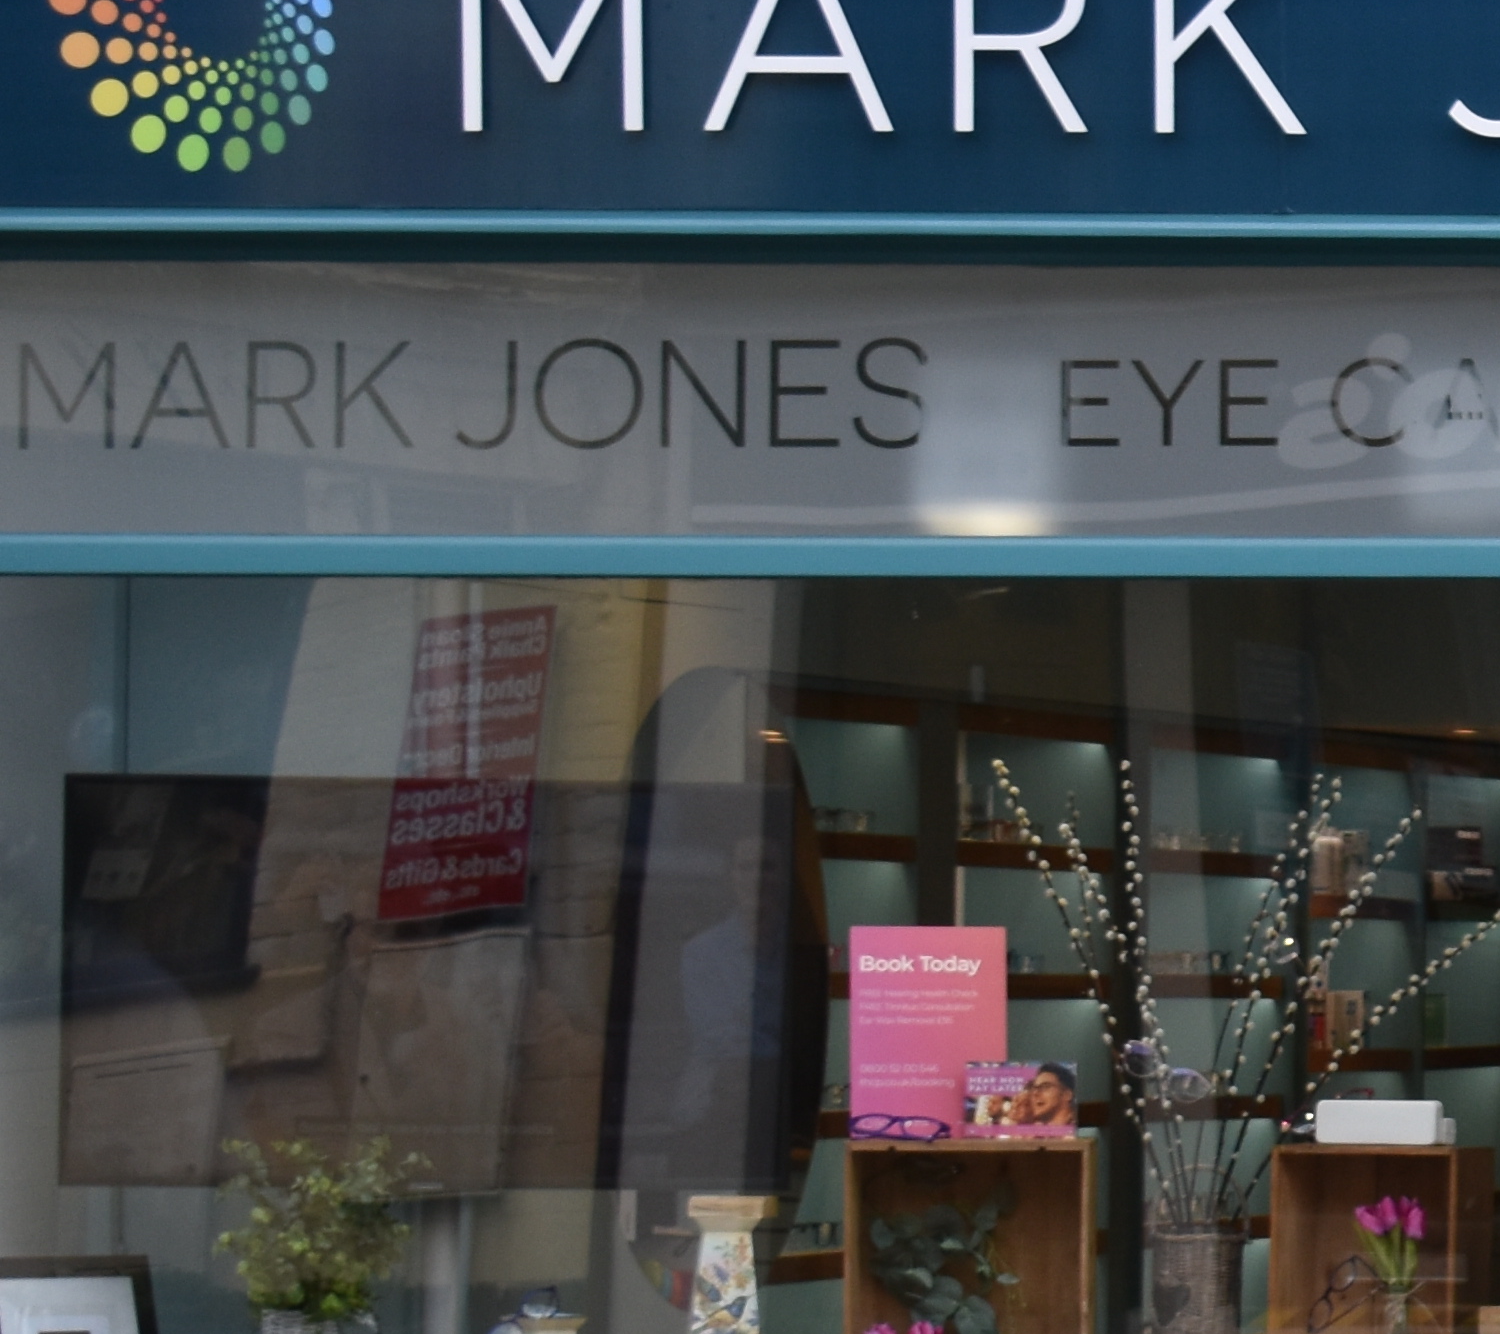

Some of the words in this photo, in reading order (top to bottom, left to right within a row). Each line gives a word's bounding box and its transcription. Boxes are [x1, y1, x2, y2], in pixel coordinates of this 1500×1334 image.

[16, 339, 414, 451] MARK
[455, 336, 929, 451] JONES
[1060, 357, 1279, 449] EYE
[859, 955, 914, 973] Book
[920, 954, 982, 977] Today
